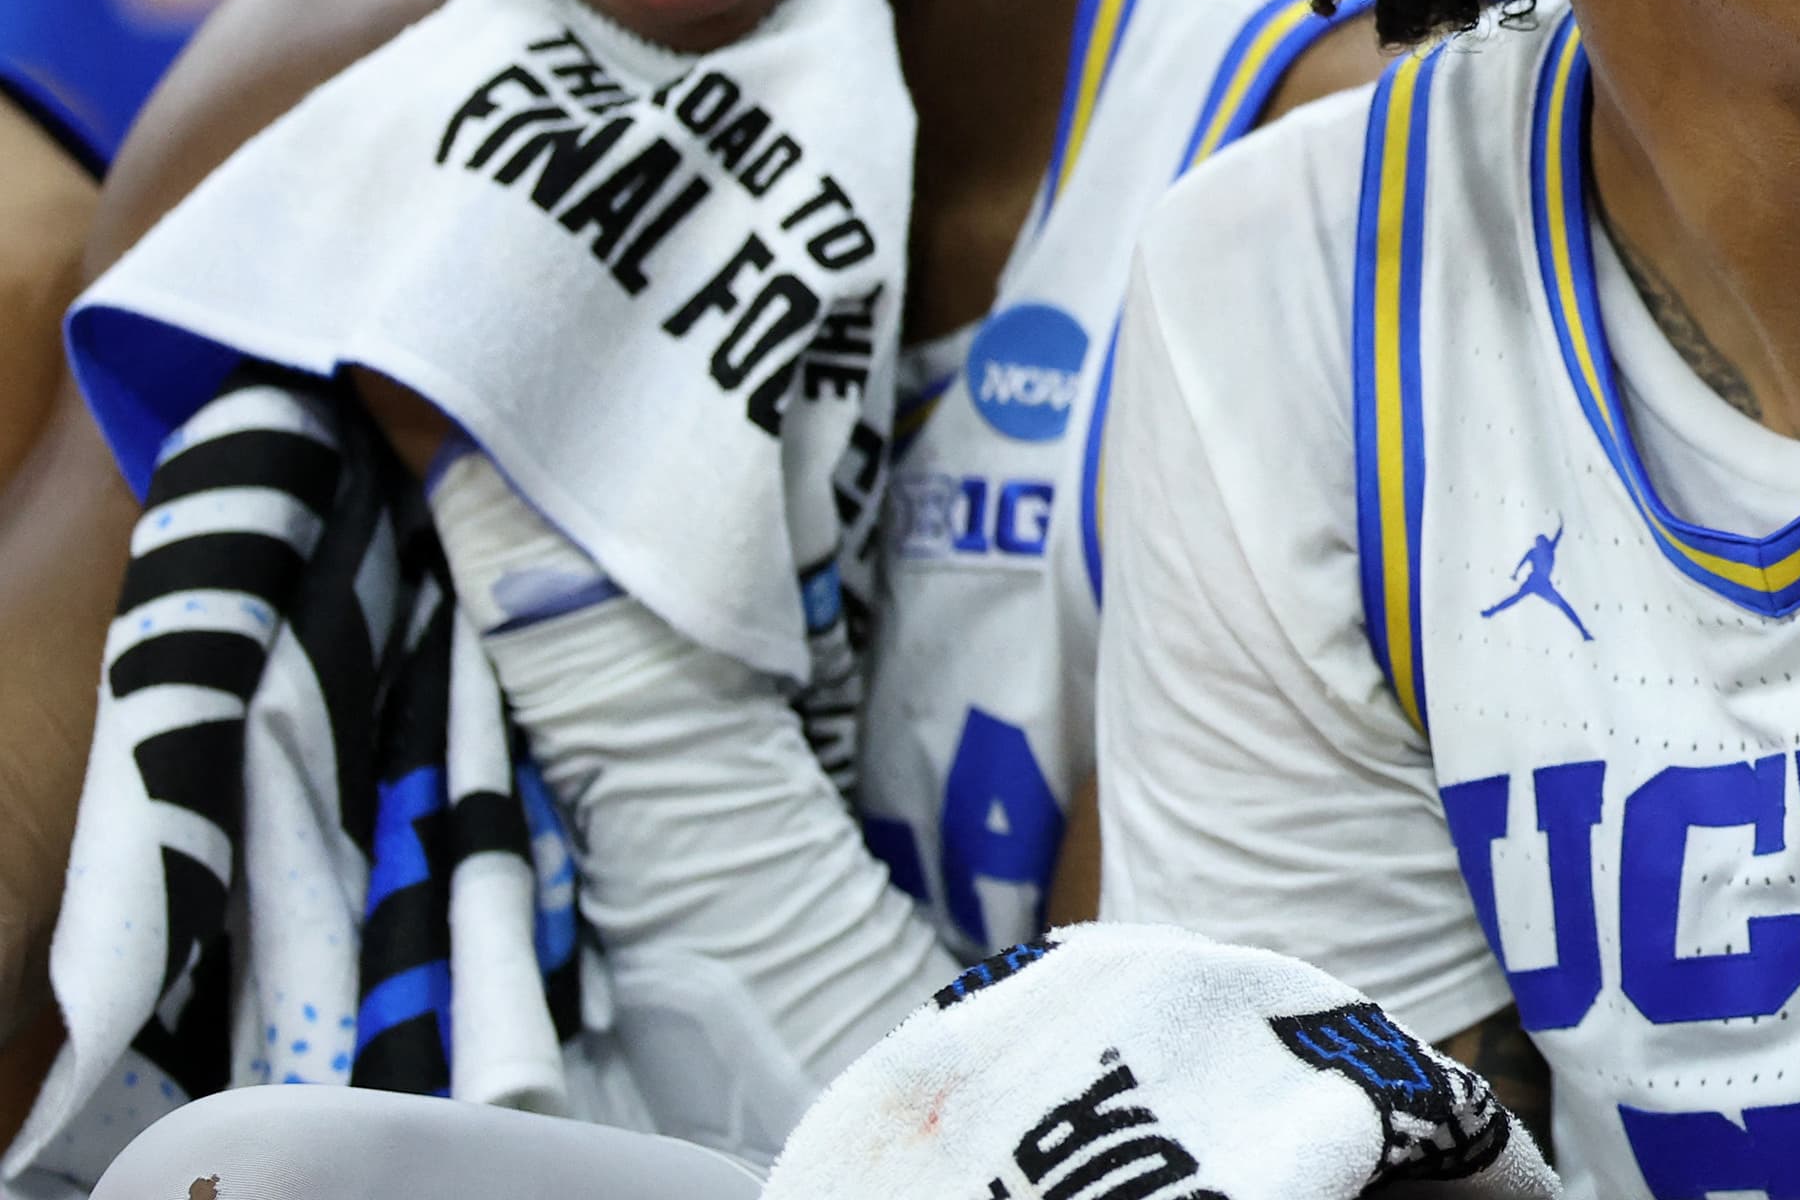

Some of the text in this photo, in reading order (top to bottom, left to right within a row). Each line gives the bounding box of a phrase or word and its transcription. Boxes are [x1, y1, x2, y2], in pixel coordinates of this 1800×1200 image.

[435, 64, 714, 299] FINAL
[651, 70, 804, 197] OAD
[780, 174, 876, 271] TO
